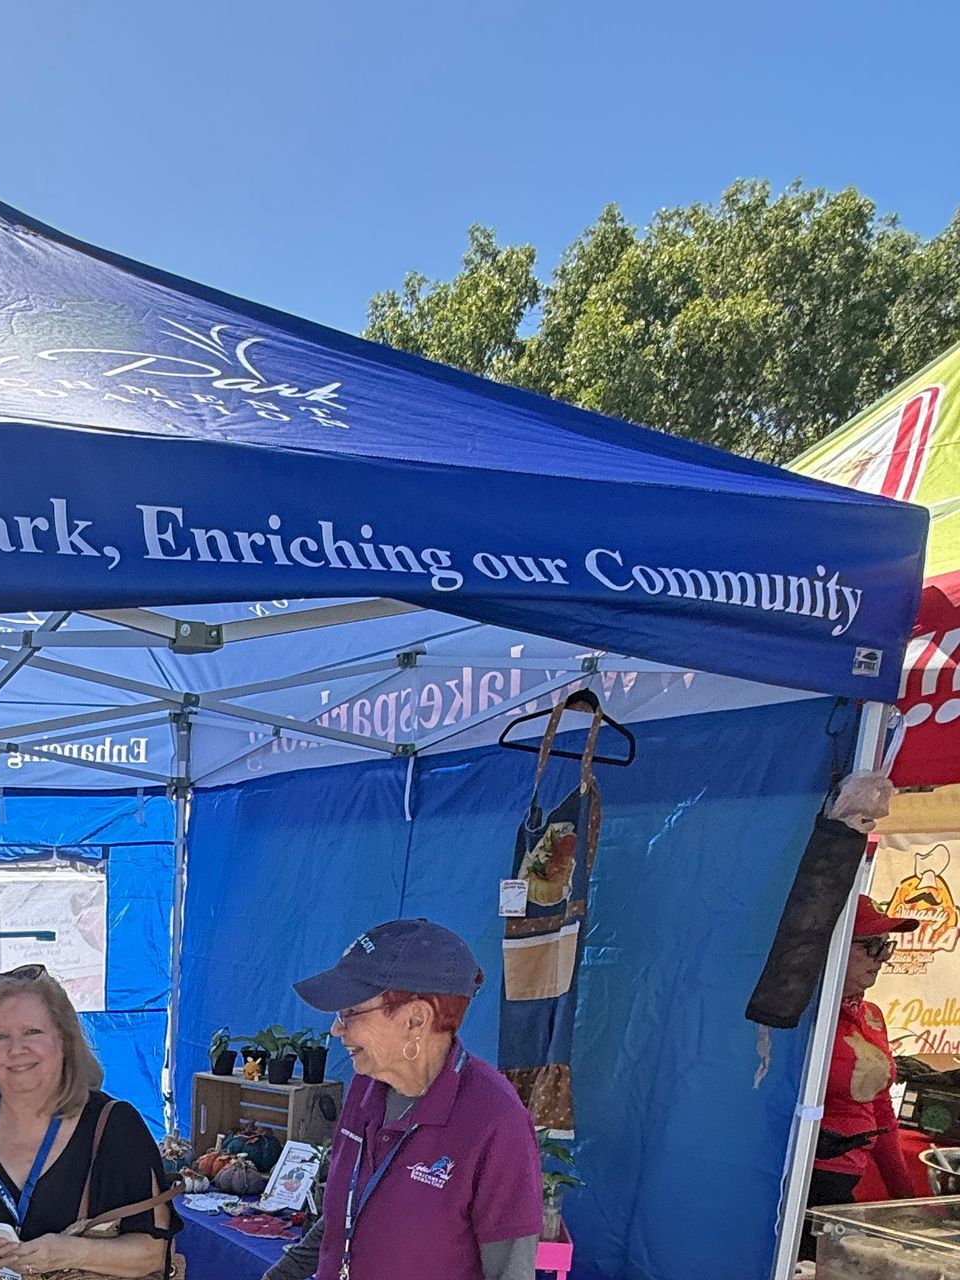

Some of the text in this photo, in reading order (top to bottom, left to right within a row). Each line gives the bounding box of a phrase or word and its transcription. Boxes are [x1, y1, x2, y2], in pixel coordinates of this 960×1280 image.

[136, 503, 465, 591] Enriching
[471, 551, 570, 587] our
[584, 548, 863, 638] Community
[889, 924, 957, 951] AELLA
